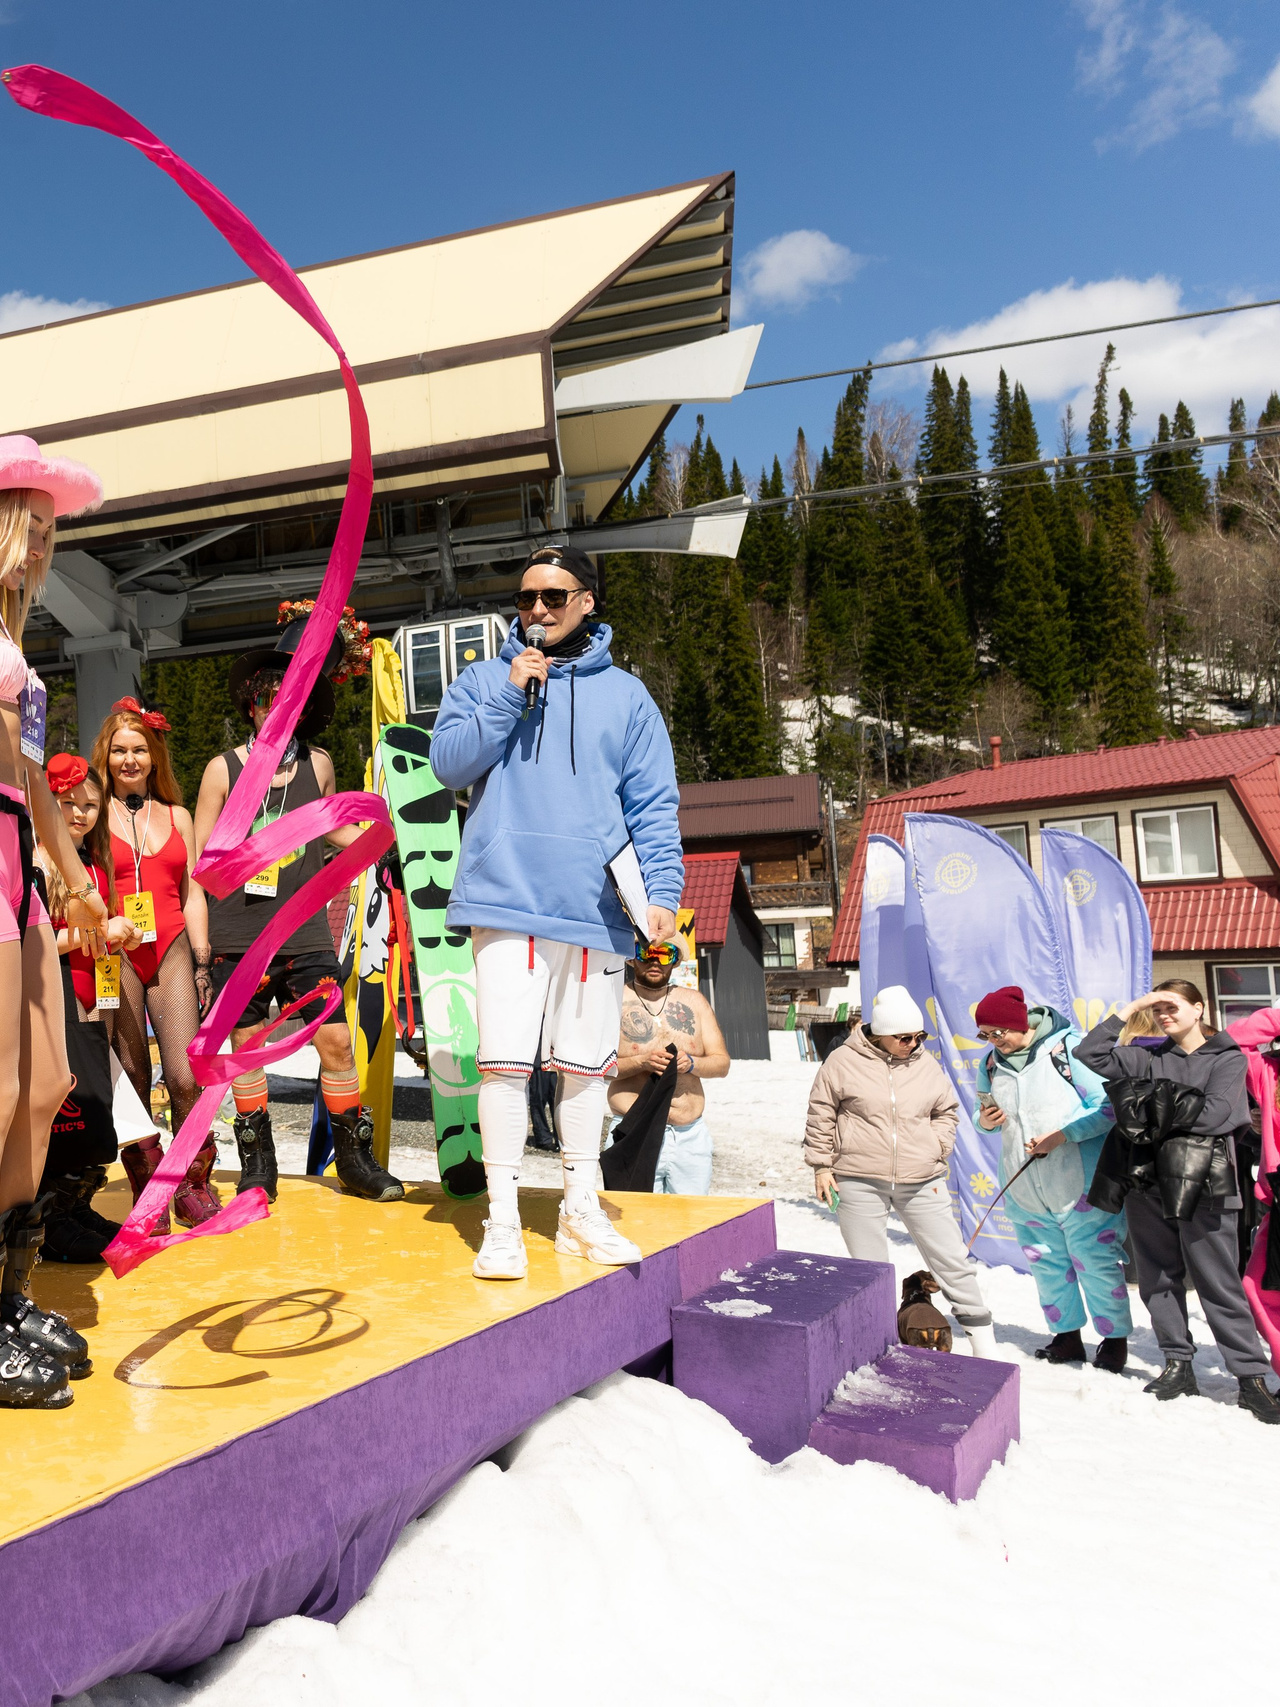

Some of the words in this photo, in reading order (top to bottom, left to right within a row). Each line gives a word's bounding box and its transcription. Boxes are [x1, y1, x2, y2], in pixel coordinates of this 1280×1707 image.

[27, 725, 39, 739] 218
[255, 874, 270, 882] 299
[134, 920, 147, 929] 217
[51, 1120, 86, 1133] TIC'S
